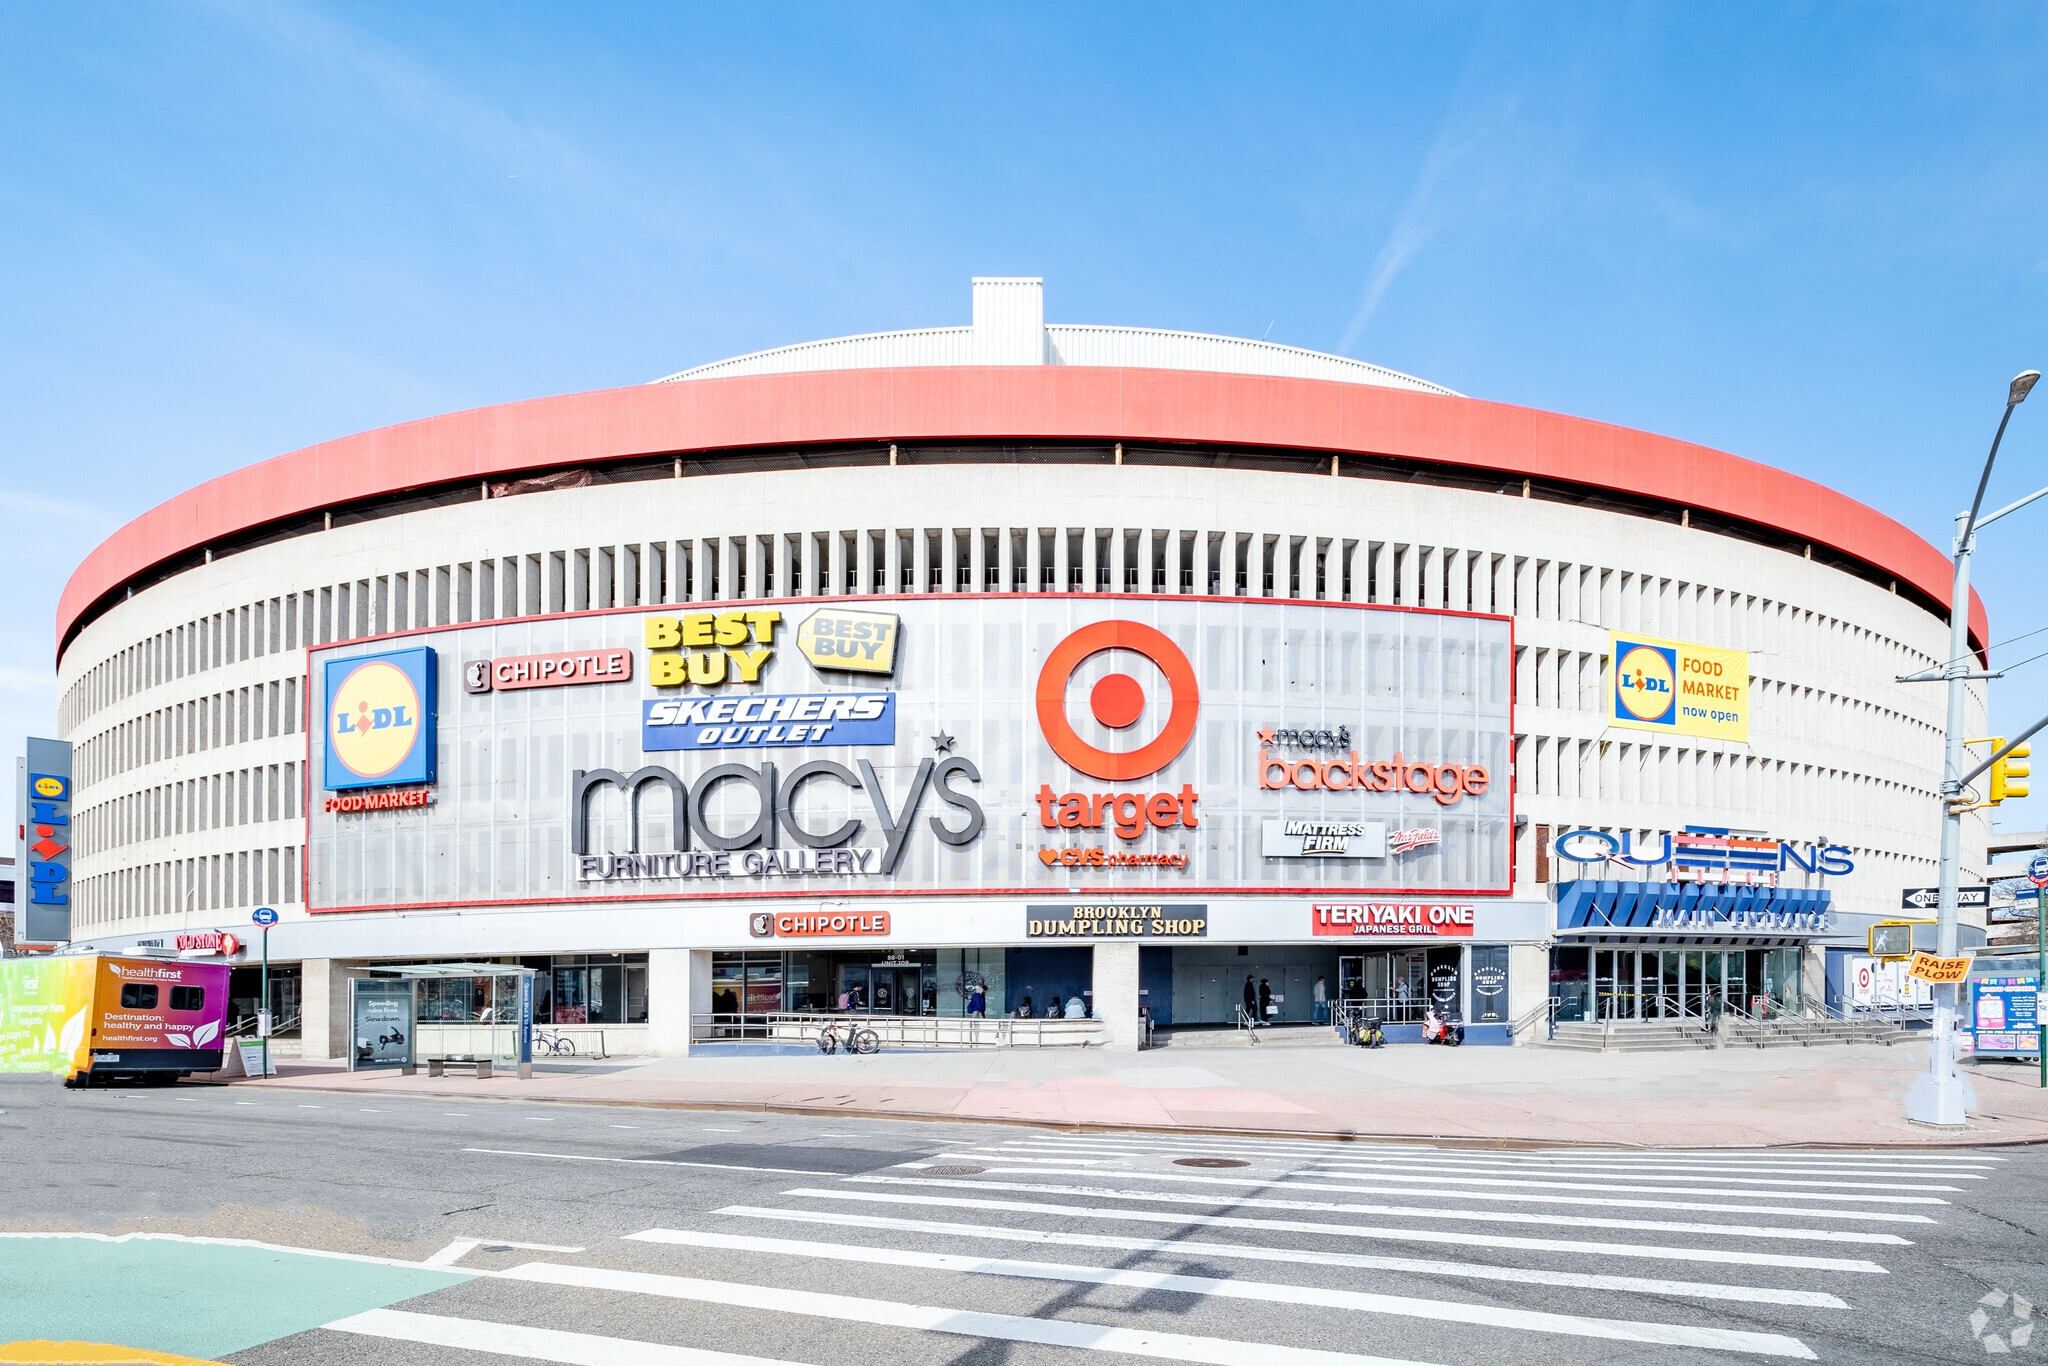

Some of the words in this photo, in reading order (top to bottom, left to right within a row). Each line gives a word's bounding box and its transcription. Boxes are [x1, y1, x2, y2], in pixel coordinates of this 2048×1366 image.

[645, 611, 782, 649] BEST
[813, 618, 892, 641] BEST
[814, 637, 883, 660] BUY
[495, 653, 624, 683] CHIPOTLE
[649, 650, 773, 688] BUY
[1683, 657, 1723, 677] FOOD
[1682, 680, 1740, 701] MARKET
[646, 695, 889, 726] SKECHERS
[1682, 706, 1707, 718] now
[1710, 709, 1739, 723] open
[697, 724, 834, 744] OUTLET
[1258, 748, 1490, 805] backstage
[323, 796, 364, 812] FOOD
[365, 789, 430, 810] MARKET
[1035, 783, 1199, 839] target
[1285, 820, 1365, 837] MATTRESS
[1303, 836, 1349, 851] FIRM
[1555, 825, 1855, 876] QUEENS
[579, 851, 730, 879] FURNITURE
[742, 849, 873, 875] GALLERY
[1060, 848, 1105, 867] CVS
[1108, 851, 1188, 869] pharmacy
[1915, 894, 1939, 903] ONE
[1957, 892, 1979, 902] AY
[1073, 906, 1162, 919] BROOKLYN
[1316, 905, 1421, 924] TERIYAKI
[1428, 905, 1474, 925] ONE
[1656, 909, 1715, 927] MAIN
[1730, 911, 1829, 931] ENTRANCE
[779, 914, 885, 932] CHIPOTLE
[1029, 919, 1144, 935] DUMPLING
[1151, 919, 1206, 935] SHOP
[1353, 925, 1407, 934] JAPANESE
[1408, 925, 1438, 934] GRILL
[174, 935, 195, 952] COLD
[195, 933, 222, 951] STONE
[121, 966, 182, 979] healthfirst
[1914, 966, 1962, 980] PLOW
[1919, 957, 1965, 970] RAISE
[103, 1022, 141, 1031] healthy
[165, 1023, 194, 1031] happy
[104, 1012, 164, 1021] Destination:
